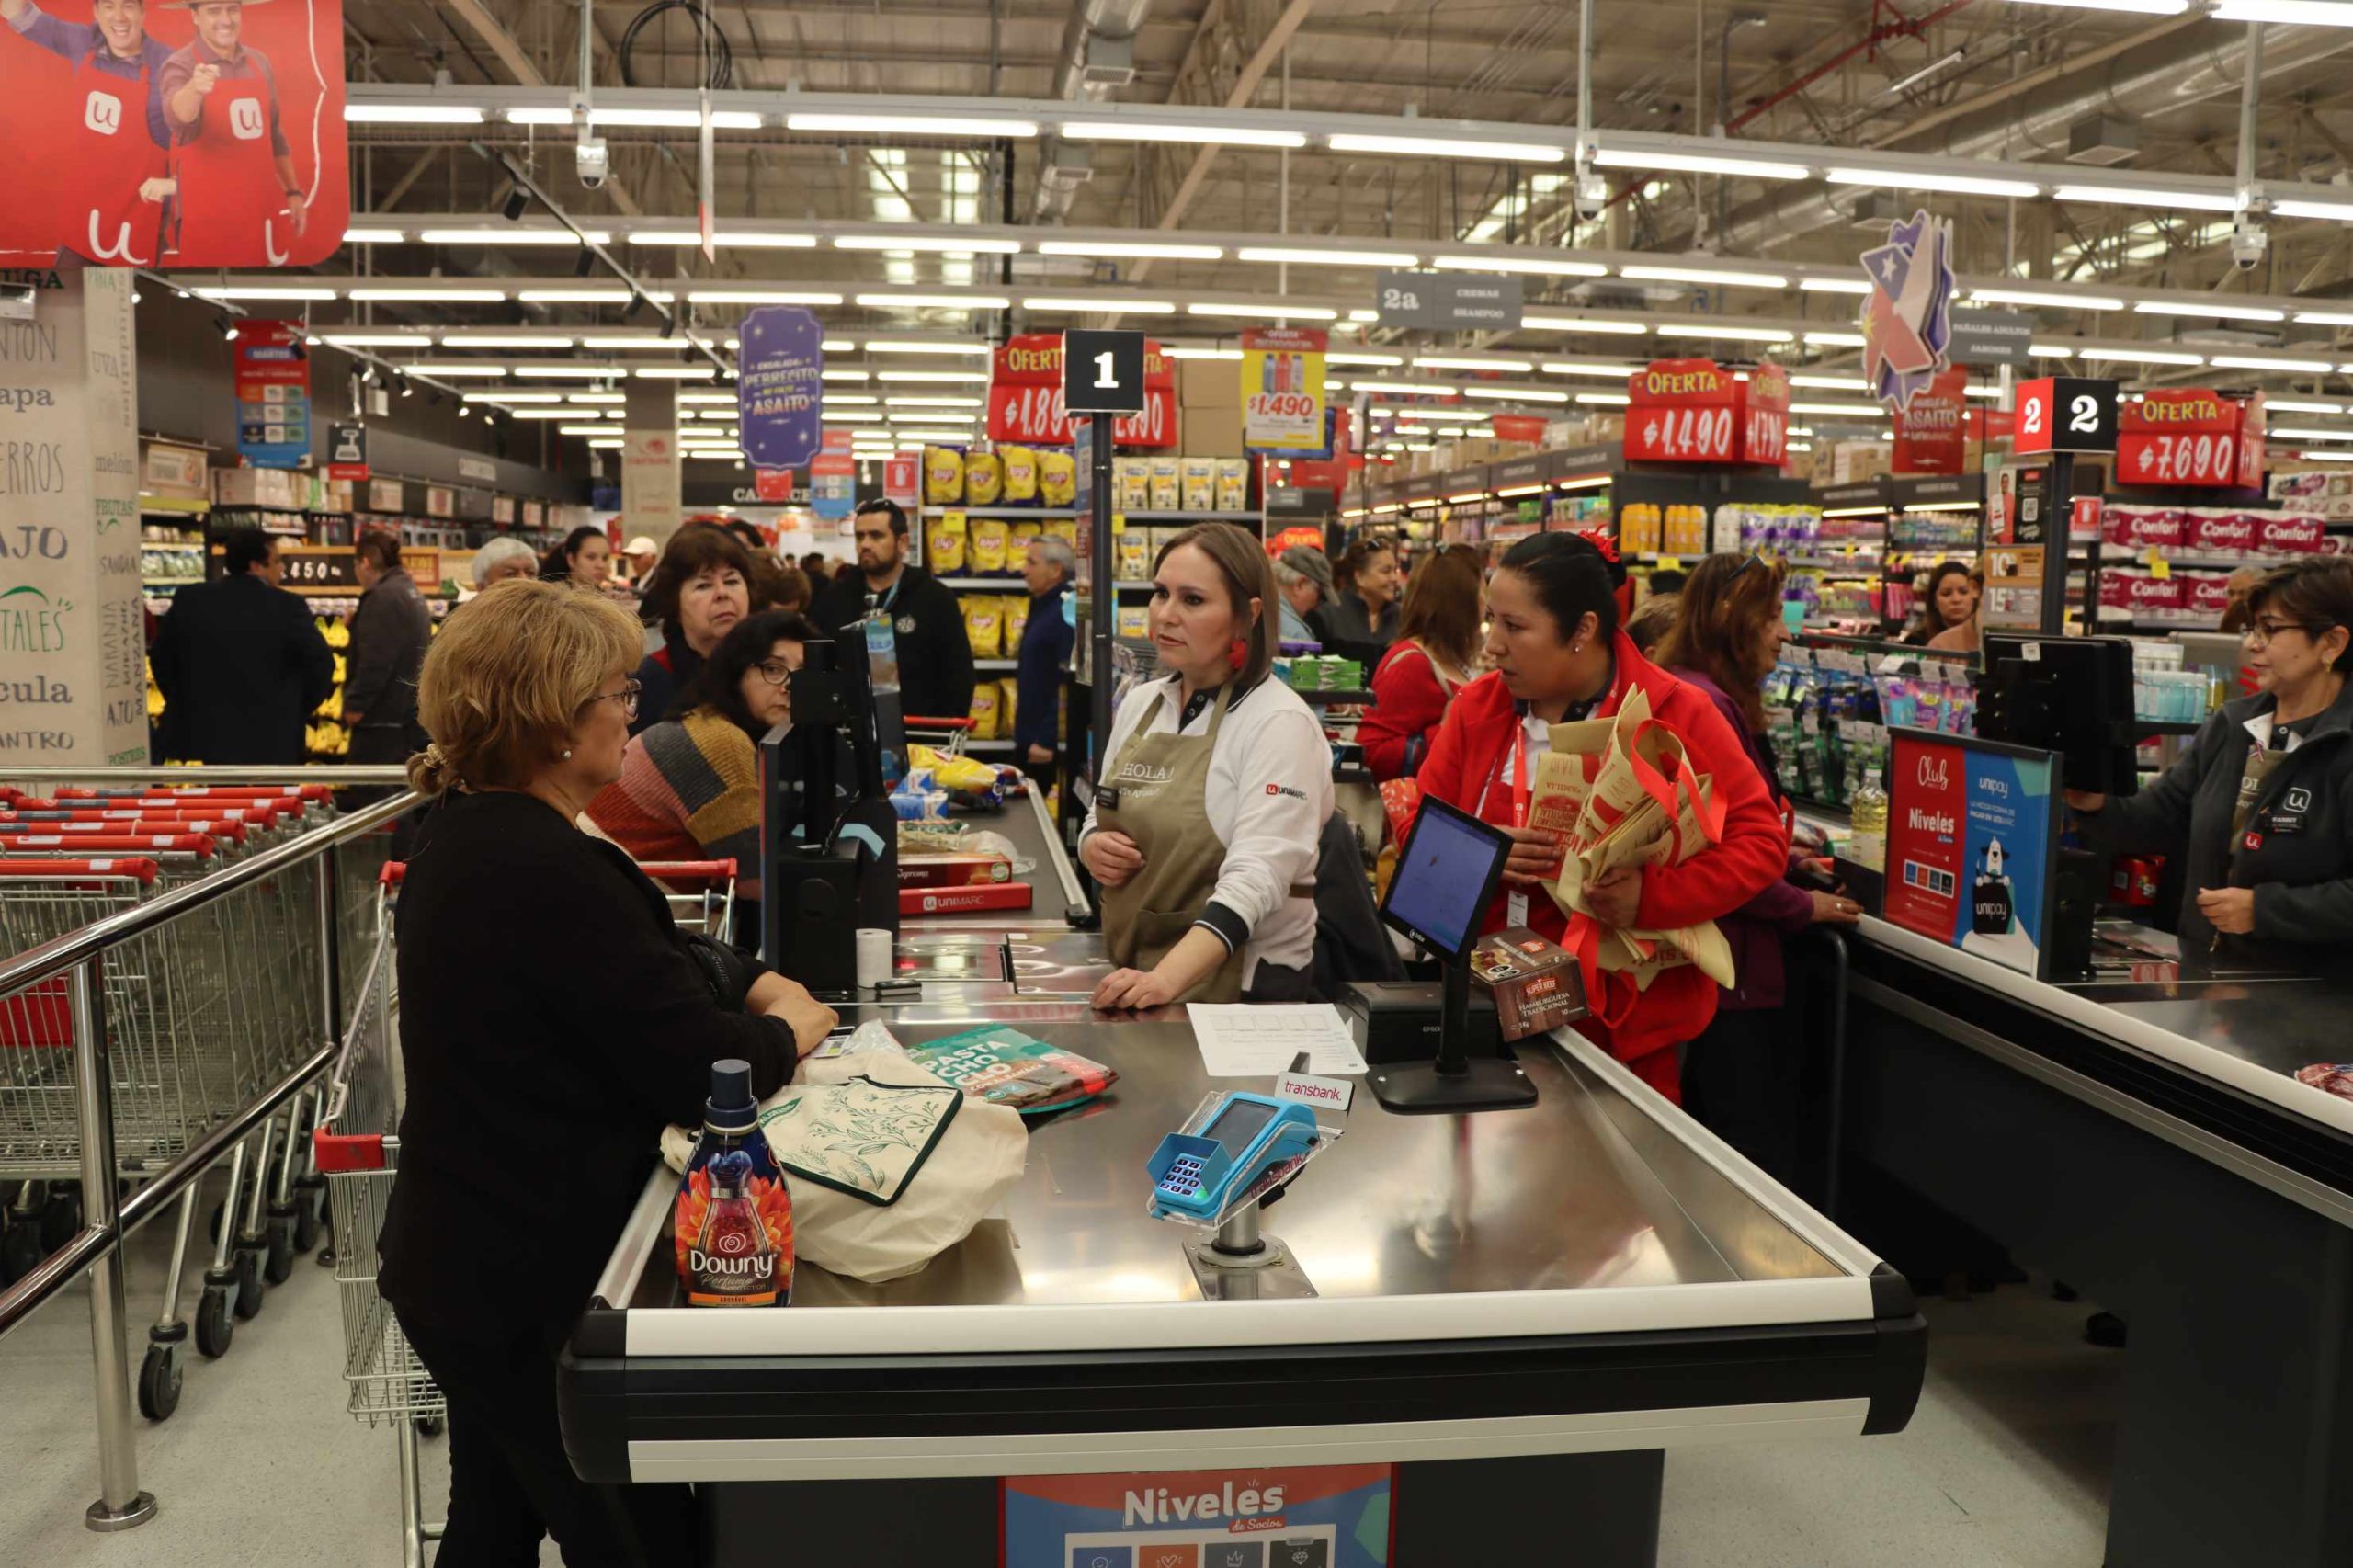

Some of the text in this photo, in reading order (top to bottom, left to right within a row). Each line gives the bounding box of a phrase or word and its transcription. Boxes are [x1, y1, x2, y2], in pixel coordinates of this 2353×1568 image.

[1383, 288, 1420, 310] 2a
[1453, 308, 1505, 318] SHAMPOO
[1093, 351, 1120, 389] 1
[1646, 371, 1718, 394] OFERTA
[1248, 395, 1313, 416] $1.490
[2024, 397, 2041, 433] 2
[2070, 395, 2099, 433] 2
[2143, 401, 2217, 422] OFERTA
[1643, 408, 1732, 456] $1.490
[2139, 435, 2233, 480] $7.690
[2131, 517, 2179, 535] Confort
[2200, 521, 2252, 539] Confort
[2264, 524, 2317, 541] Confort
[2131, 581, 2179, 597] Confort
[1918, 756, 1948, 790] Club
[1979, 777, 2008, 799] unipay
[1909, 807, 1954, 834] Niveles
[938, 896, 984, 908] UNIMARC
[1976, 903, 2006, 920] unipay
[1526, 978, 1556, 994] SUPER BEEF
[1518, 993, 1570, 1011] HAMBURGUESA
[1523, 1000, 1568, 1017] TRADICIONAL
[921, 1040, 1011, 1071] PASTA
[936, 1053, 1000, 1077] CHO
[954, 1062, 1012, 1086] CLO
[690, 1249, 773, 1278] Downy
[700, 1273, 754, 1288] Perfume
[1124, 1481, 1284, 1526] Niveles
[1233, 1518, 1282, 1532] de Socios
